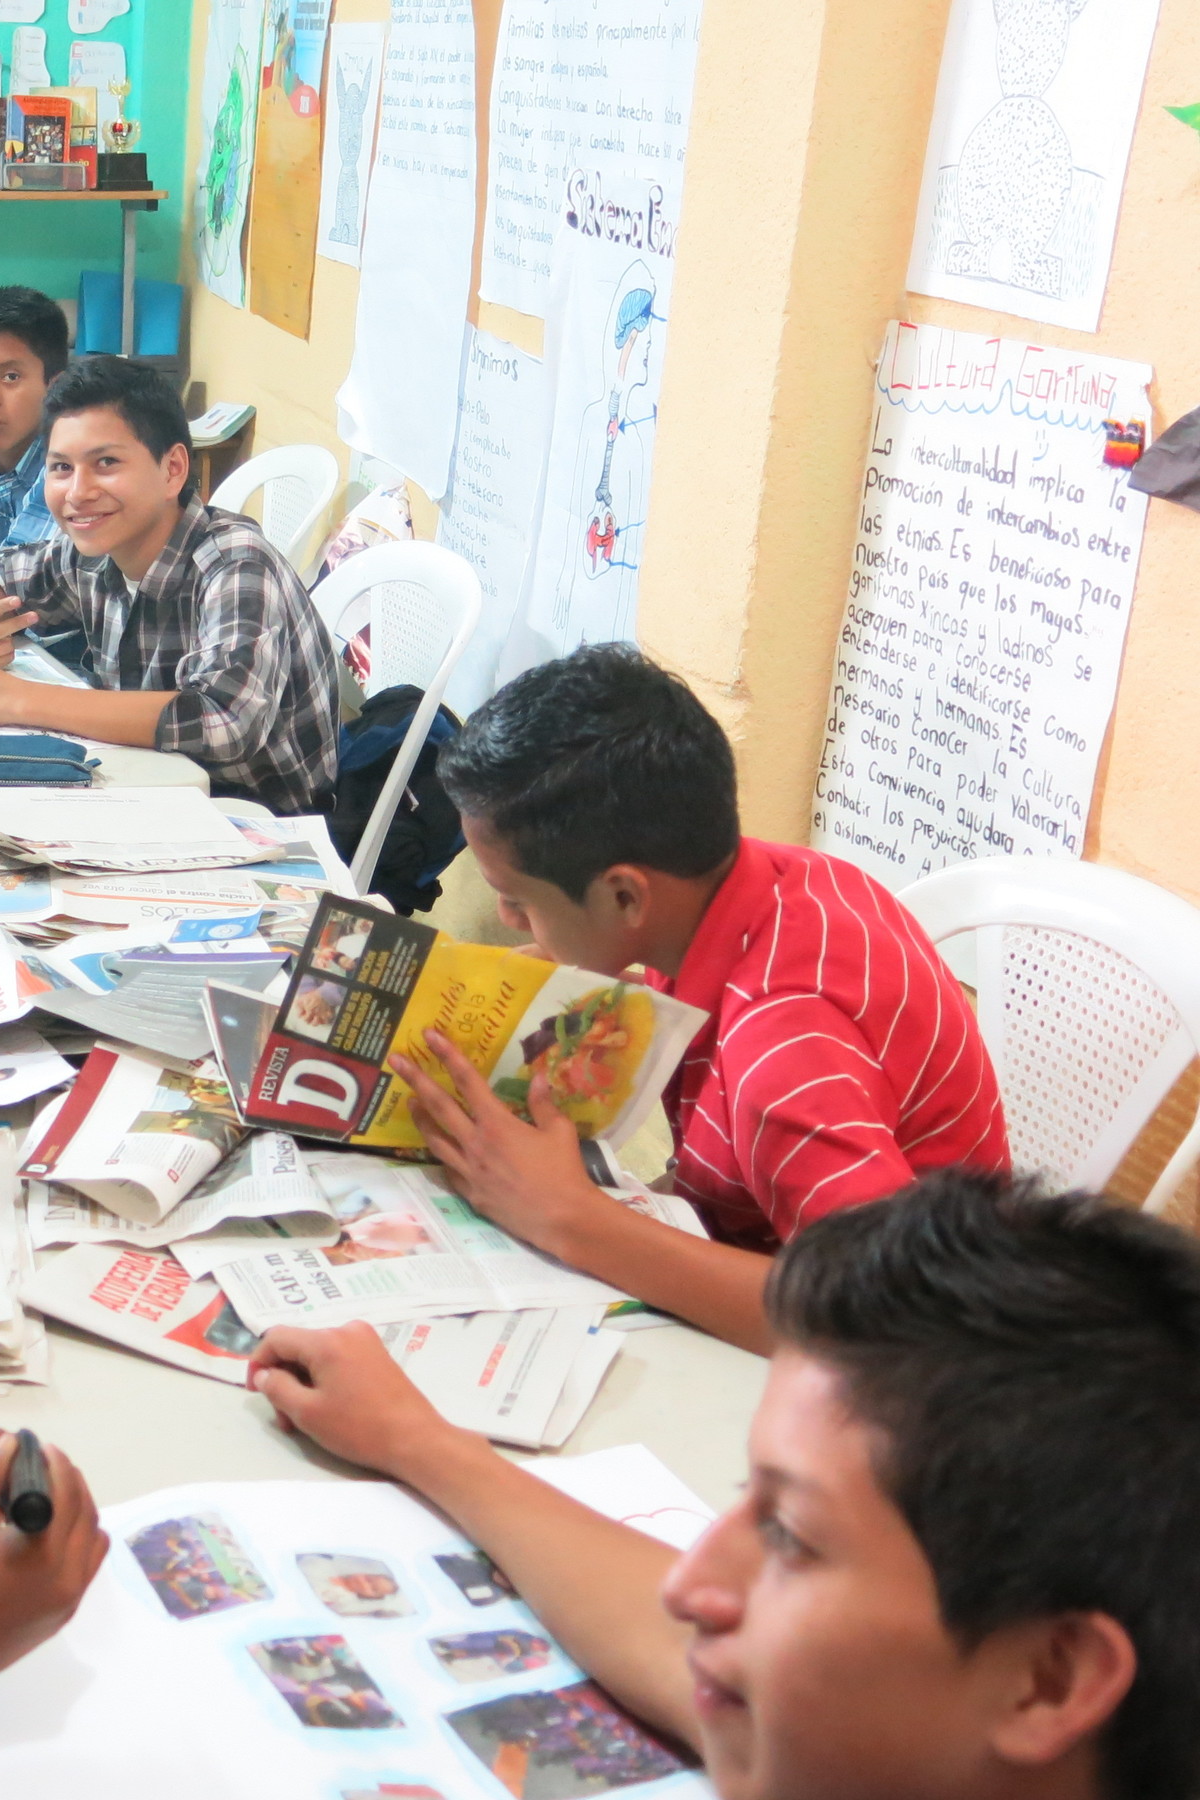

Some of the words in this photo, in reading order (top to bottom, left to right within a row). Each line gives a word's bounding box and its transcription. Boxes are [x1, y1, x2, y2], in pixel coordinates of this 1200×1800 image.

[872, 405, 893, 456] La
[1029, 463, 1085, 506] implica
[1109, 477, 1127, 513] la
[860, 505, 883, 536] las
[950, 528, 972, 562] Es
[989, 538, 1071, 590] beneficioso
[957, 486, 974, 517] de
[987, 496, 1080, 550] intercambios
[1087, 526, 1131, 563] entre
[855, 543, 909, 577] nuestro
[959, 580, 986, 611] que
[995, 583, 1017, 613] los
[847, 604, 908, 640] acerquen
[912, 630, 943, 657] para
[849, 570, 915, 610] garifunas
[978, 623, 987, 655] y
[998, 618, 1054, 669] ladinos
[837, 645, 904, 700] hermanos
[913, 687, 923, 719] y
[842, 623, 918, 672] entenderse
[927, 663, 937, 681] e
[945, 670, 1031, 724] identificarse
[828, 708, 846, 735] de
[860, 725, 897, 755] otros
[834, 685, 900, 729] nesesario
[992, 748, 1007, 778] la
[819, 737, 854, 778] Esta
[956, 806, 1015, 853] ayudara
[883, 794, 905, 827] los
[814, 810, 826, 832] el
[834, 820, 906, 866] aislamiento
[82, 882, 99, 891] vez
[101, 884, 126, 894] otra
[128, 885, 164, 896] cáncer
[166, 887, 178, 897] el
[180, 888, 216, 900] contra
[219, 891, 252, 901] Lucha
[258, 1047, 289, 1102] REVISTA
[276, 1057, 360, 1123] D
[89, 1250, 158, 1313] AUTOFERIA
[142, 1258, 191, 1311] VERANO
[129, 1302, 161, 1322] DE
